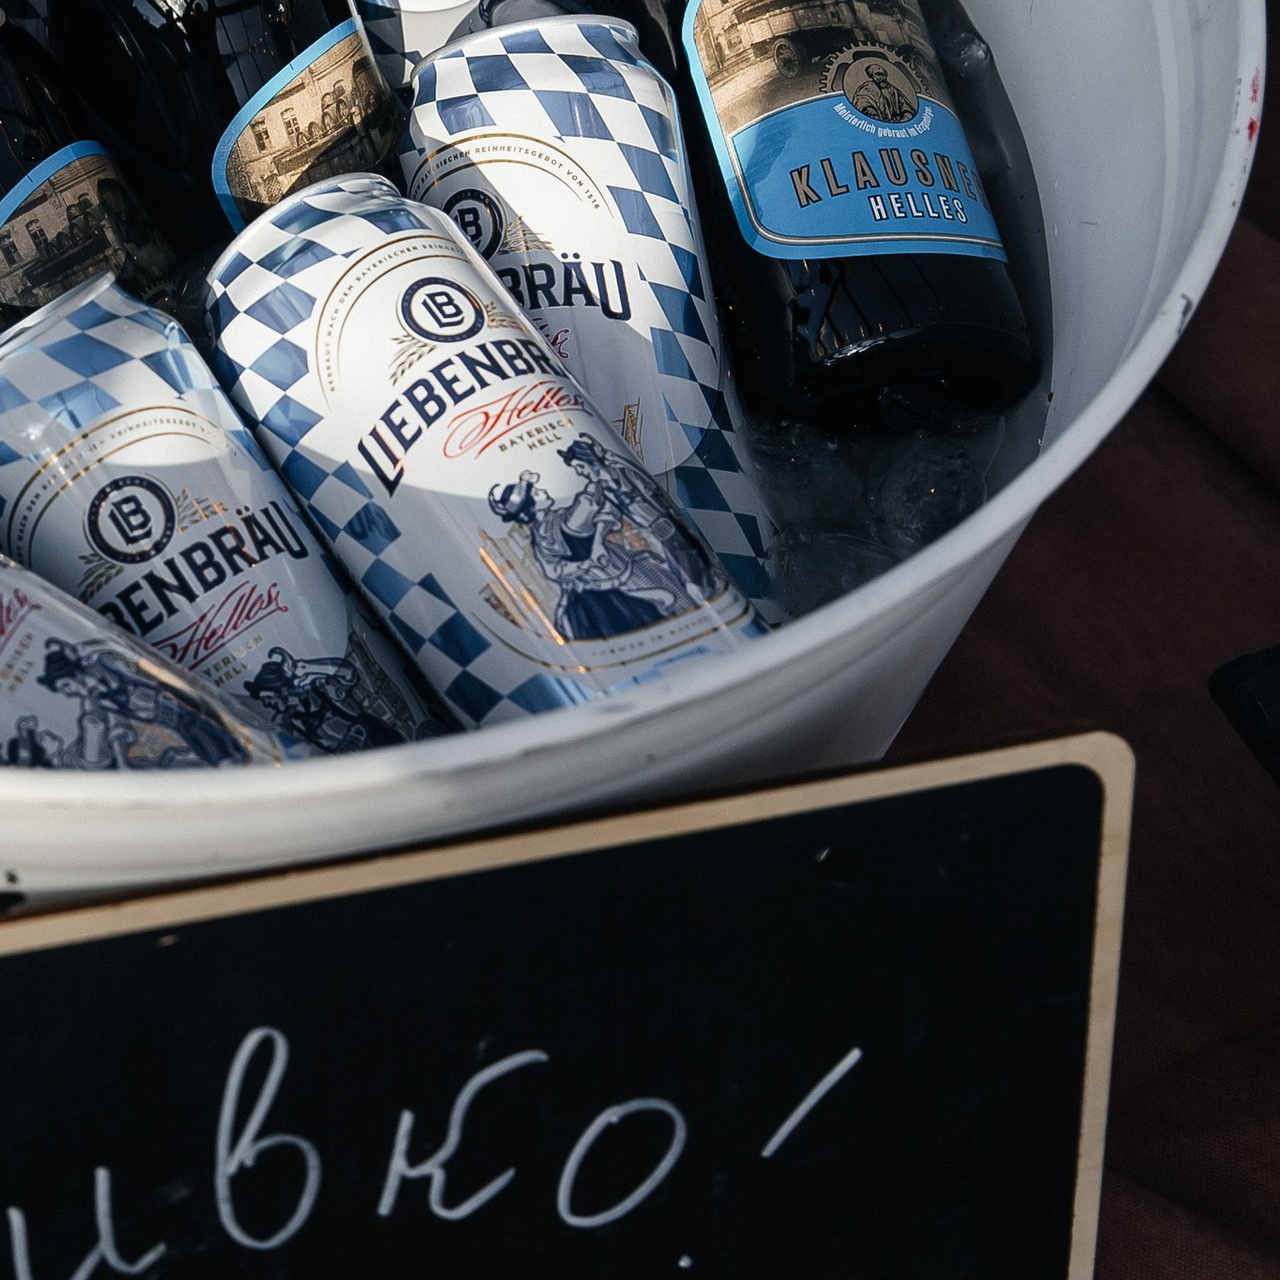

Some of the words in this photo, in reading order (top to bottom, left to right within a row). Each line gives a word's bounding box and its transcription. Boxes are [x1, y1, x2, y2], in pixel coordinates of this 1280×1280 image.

[833, 102, 876, 134] Meisterlich
[473, 144, 564, 169] REINHEITSGEBOT
[564, 168, 585, 188] VON
[583, 188, 602, 210] 1516
[868, 192, 968, 224] HELLES
[422, 291, 465, 328] LB
[357, 338, 569, 498] LIEBENBR
[528, 434, 562, 451] HELL
[108, 494, 153, 546] LB
